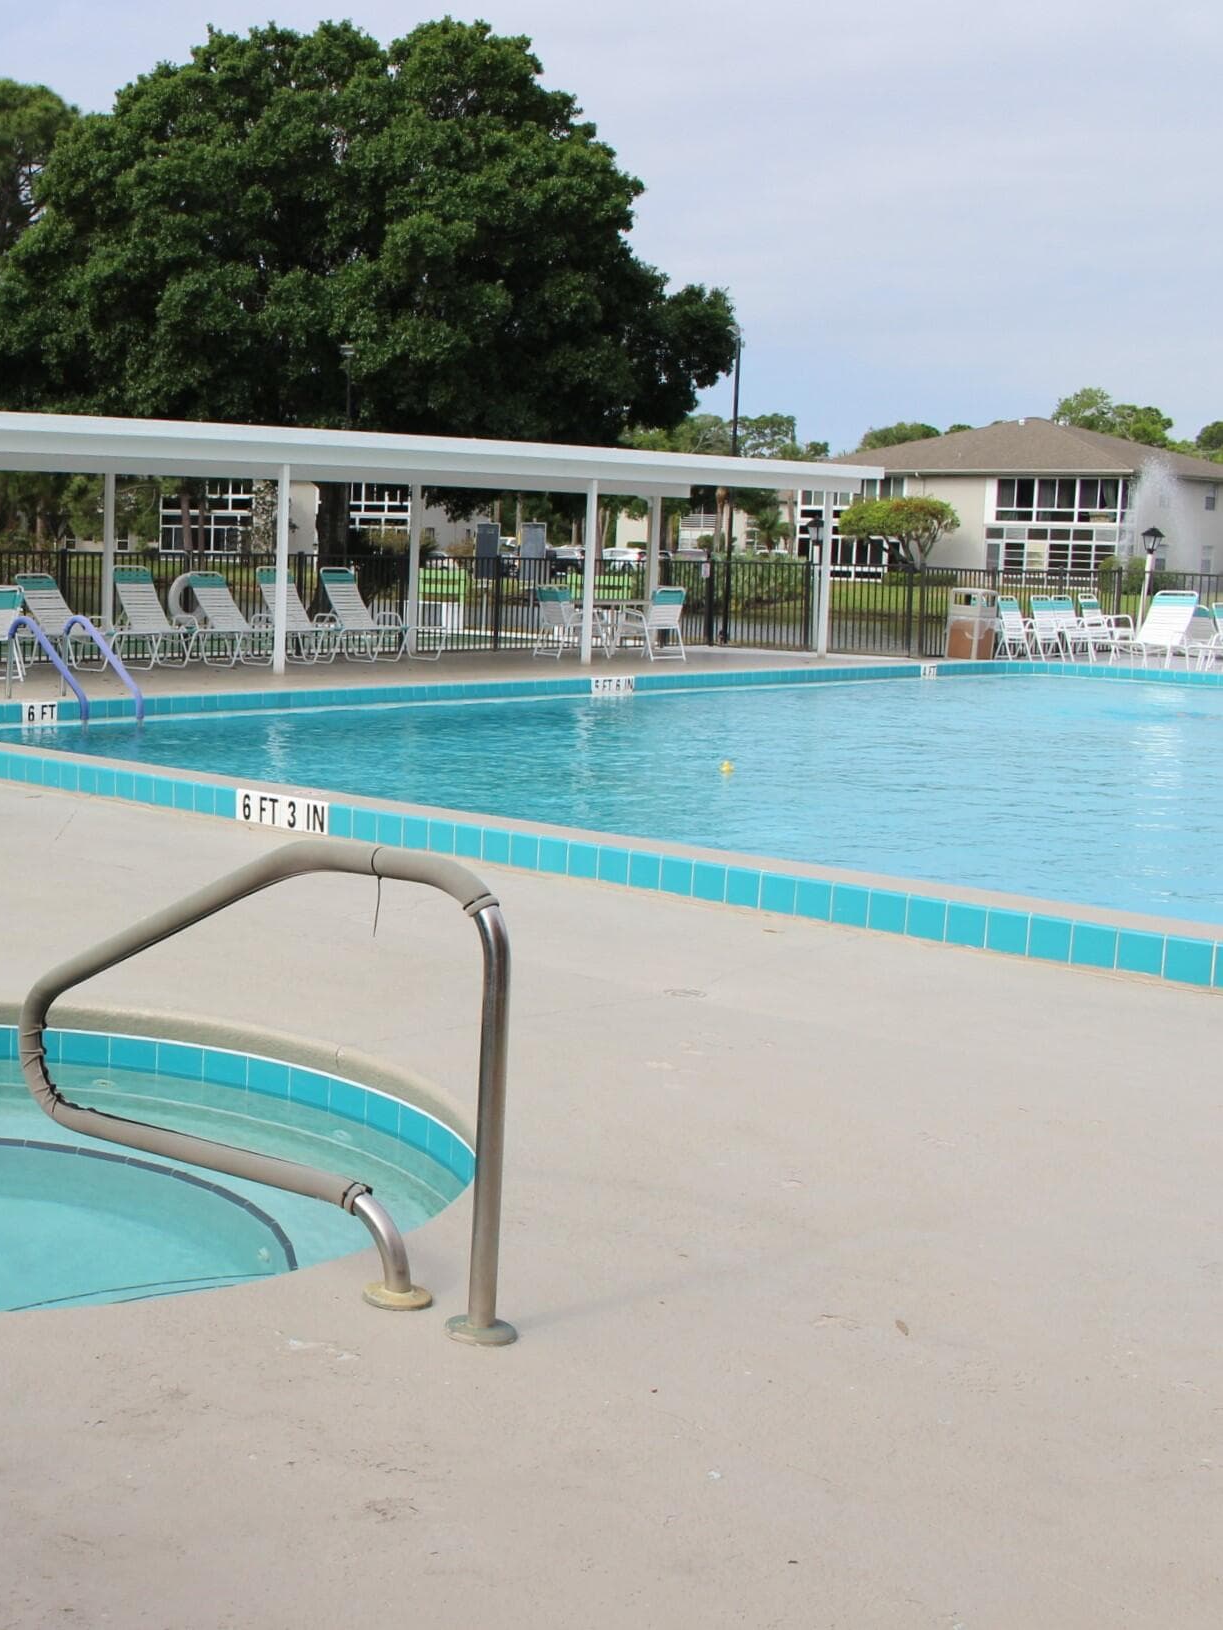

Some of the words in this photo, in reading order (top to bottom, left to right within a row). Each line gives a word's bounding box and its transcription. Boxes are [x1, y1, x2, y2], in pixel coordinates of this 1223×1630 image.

[602, 679, 613, 691] FT
[624, 678, 634, 690] IN
[28, 704, 35, 722] 6
[41, 703, 56, 720] FT
[242, 793, 251, 821] 6
[259, 796, 279, 825] FT
[287, 801, 296, 829] 3
[307, 803, 325, 833] IN
